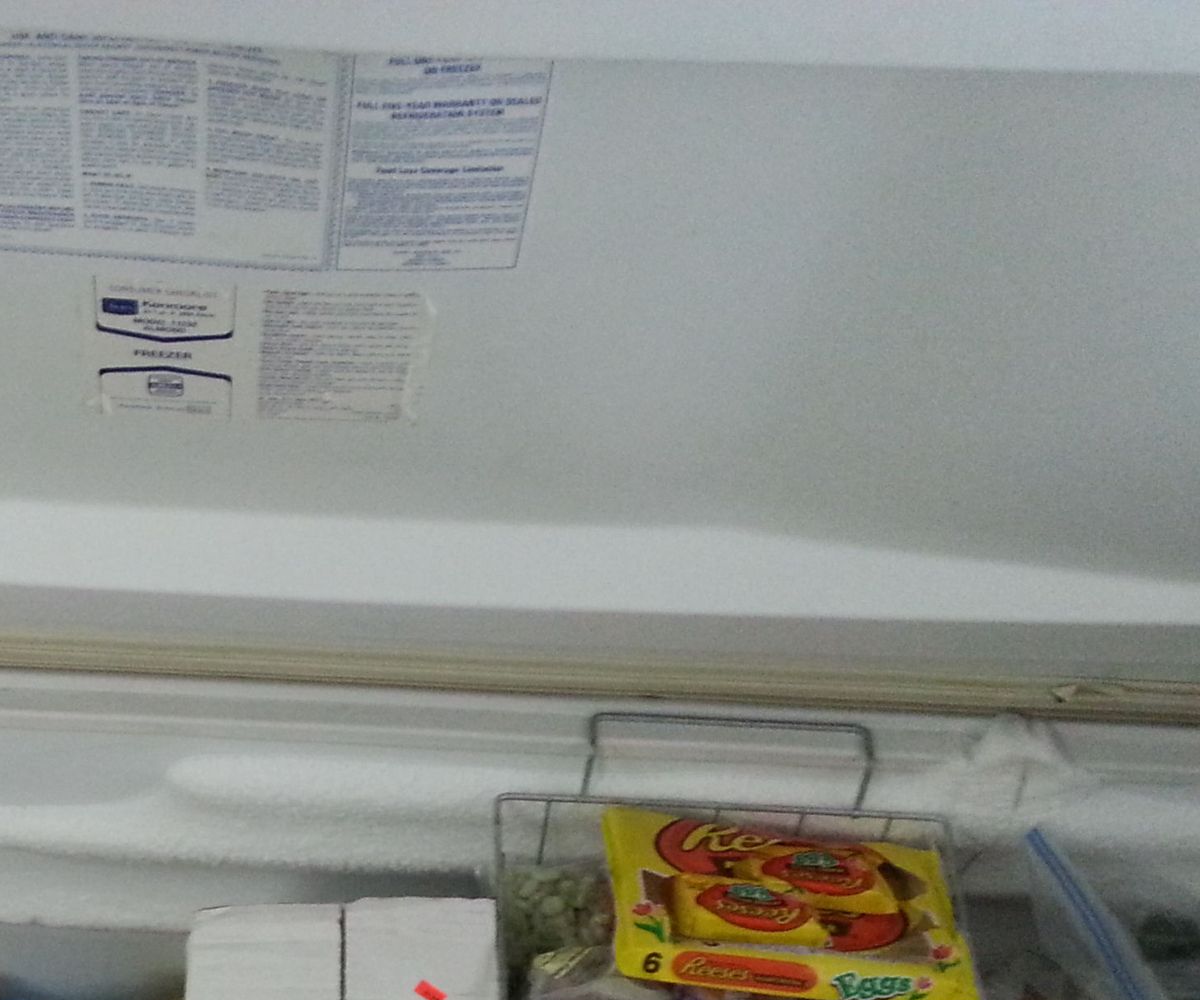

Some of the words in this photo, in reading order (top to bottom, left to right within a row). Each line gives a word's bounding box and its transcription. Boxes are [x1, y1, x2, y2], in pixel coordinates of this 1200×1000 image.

[133, 349, 193, 359] FREEZER
[641, 951, 663, 973] 6
[833, 971, 914, 1000] Eggs
